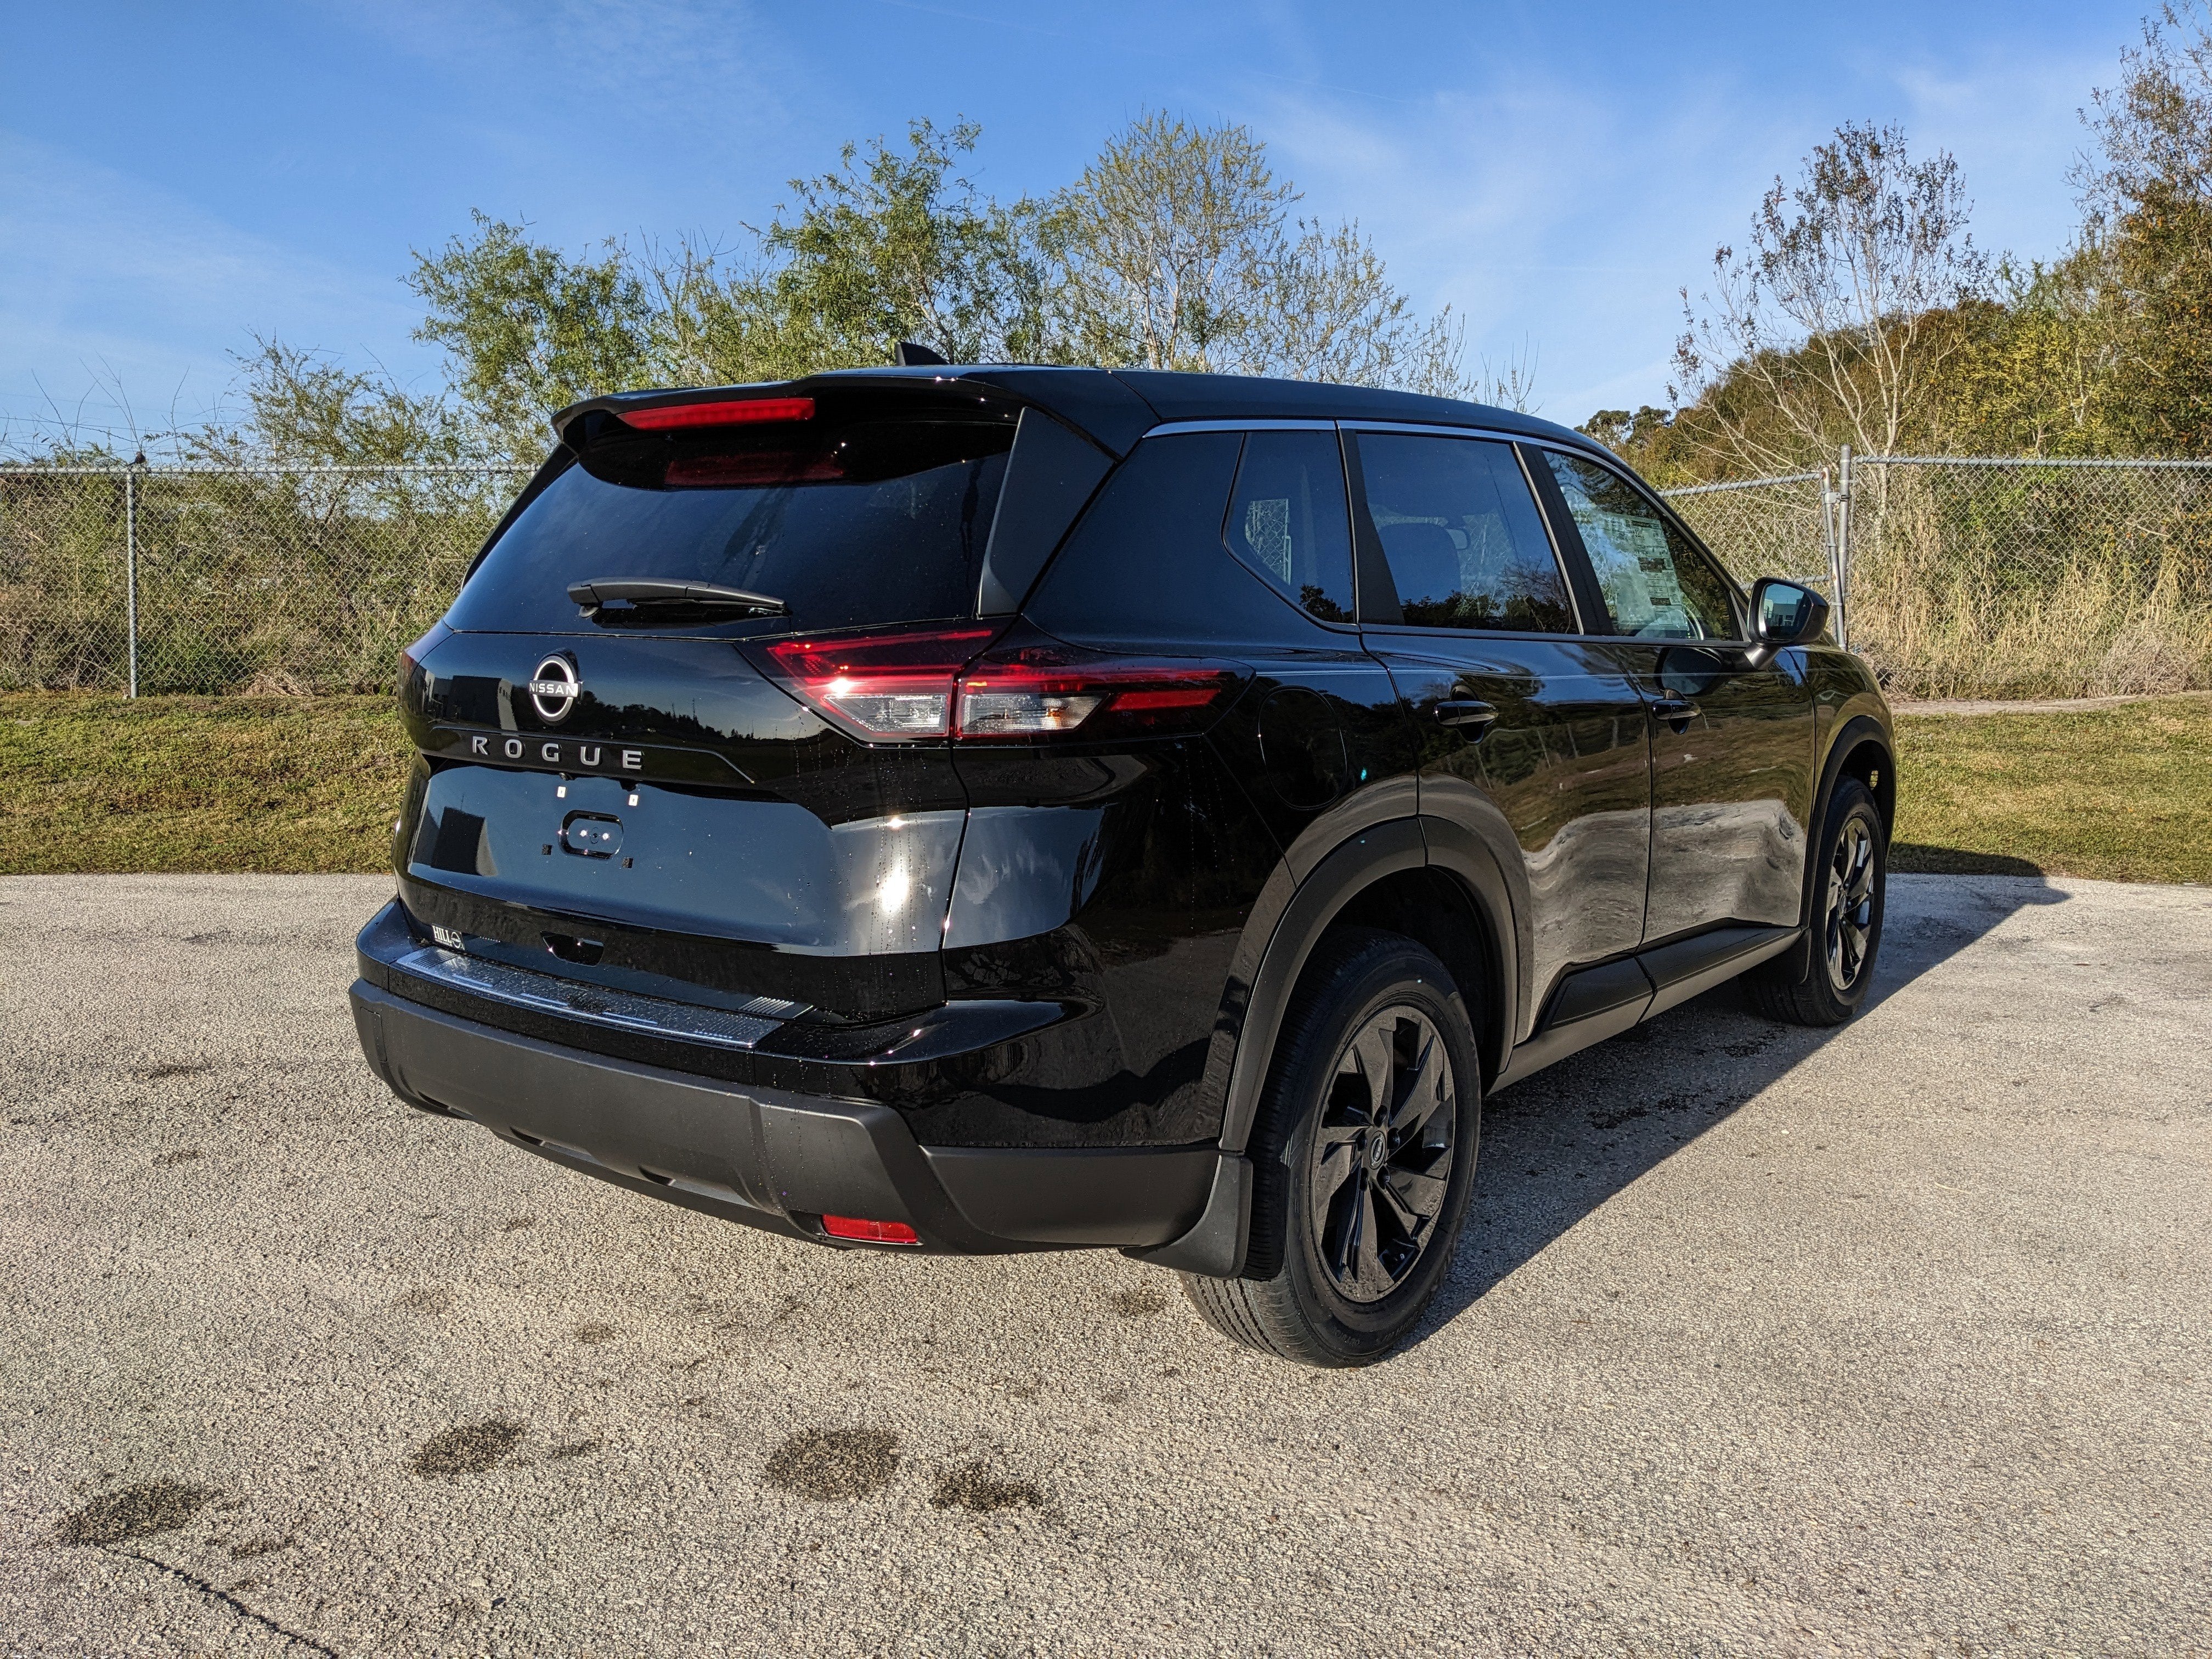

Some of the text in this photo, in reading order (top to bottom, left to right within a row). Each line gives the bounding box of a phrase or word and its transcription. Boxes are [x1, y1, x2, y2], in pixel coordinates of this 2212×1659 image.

[529, 682, 574, 696] NISSAN
[472, 736, 642, 770] ROGUE
[432, 925, 452, 944] HILL
